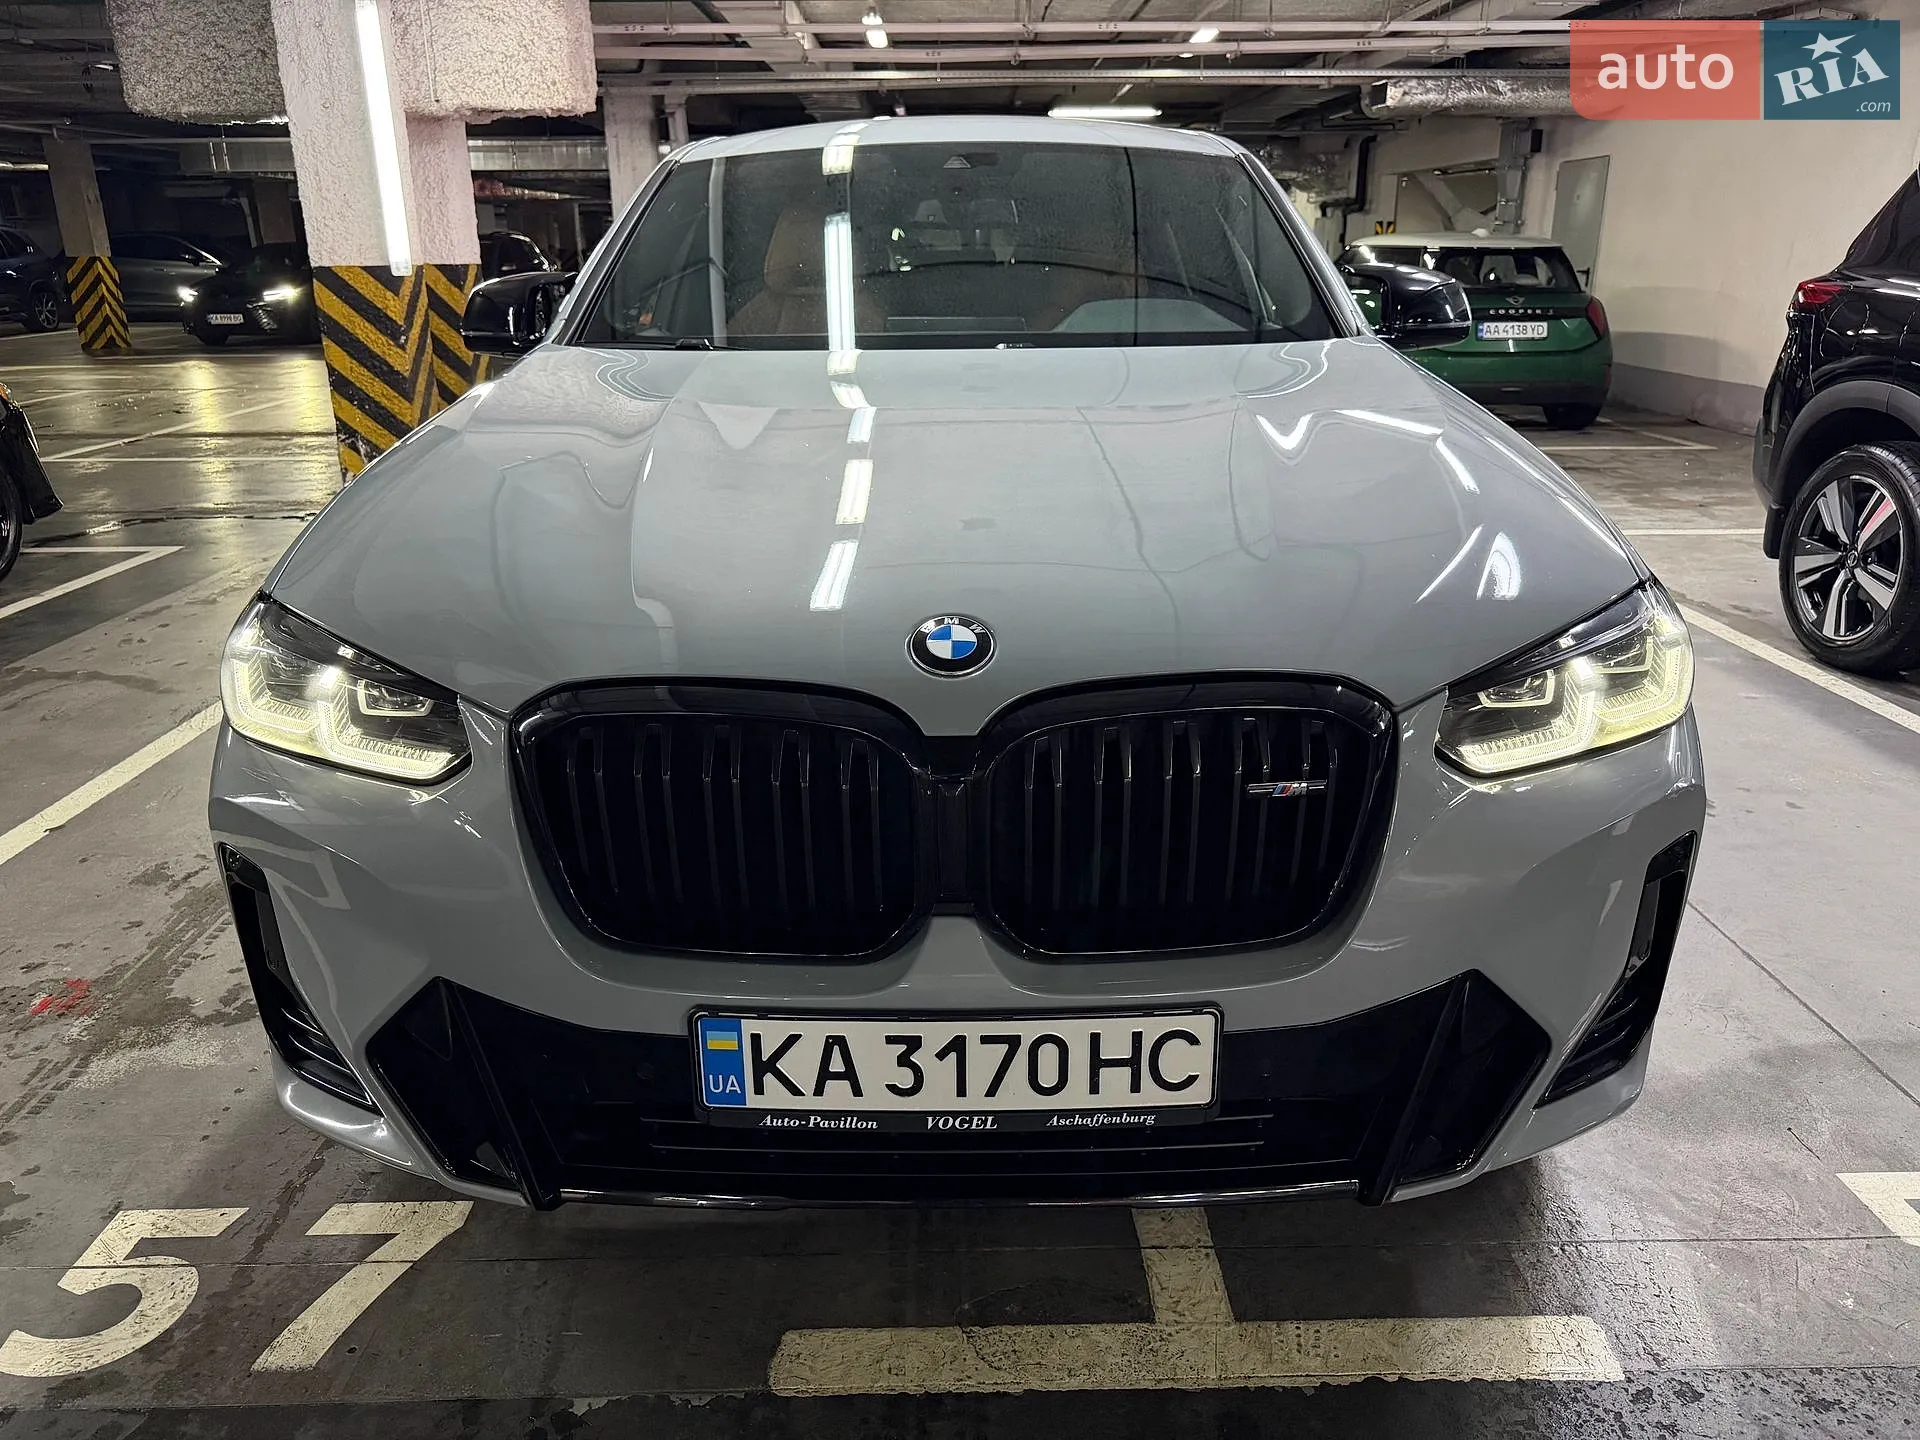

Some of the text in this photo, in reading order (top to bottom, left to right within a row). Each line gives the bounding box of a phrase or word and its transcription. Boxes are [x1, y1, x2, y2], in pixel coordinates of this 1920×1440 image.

[1485, 324, 1500, 336] AA
[1502, 324, 1528, 336] 4138
[1530, 324, 1545, 336] YD
[920, 616, 986, 634] BMW
[750, 1028, 1202, 1098] KA 3170 HC
[709, 1074, 742, 1094] UA
[759, 1111, 1157, 1130] Auto-Pavillon VOGEL Aschaffenburg
